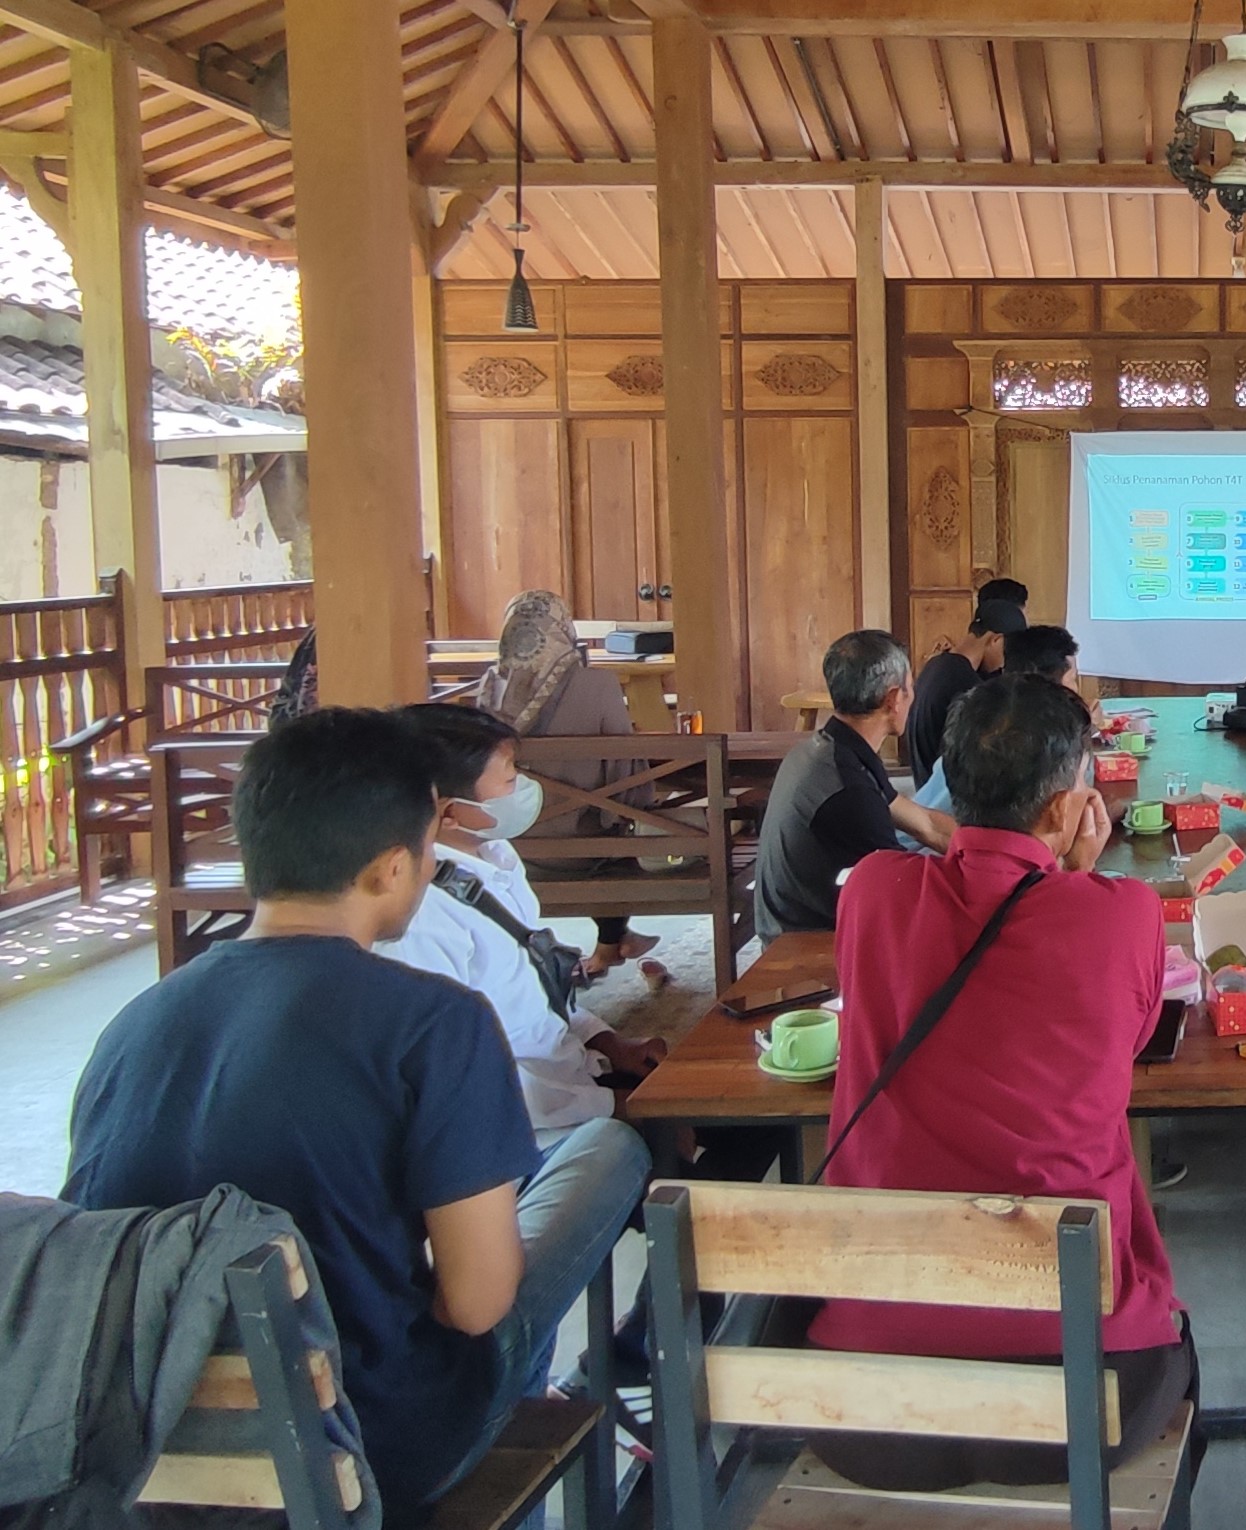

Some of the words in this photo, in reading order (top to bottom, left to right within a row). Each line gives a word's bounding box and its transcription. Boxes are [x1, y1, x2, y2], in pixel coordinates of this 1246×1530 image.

[1103, 474, 1130, 485] Siklus
[1132, 475, 1189, 485] Penanaman
[1191, 474, 1223, 485] Pohon
[1225, 475, 1243, 485] T4T
